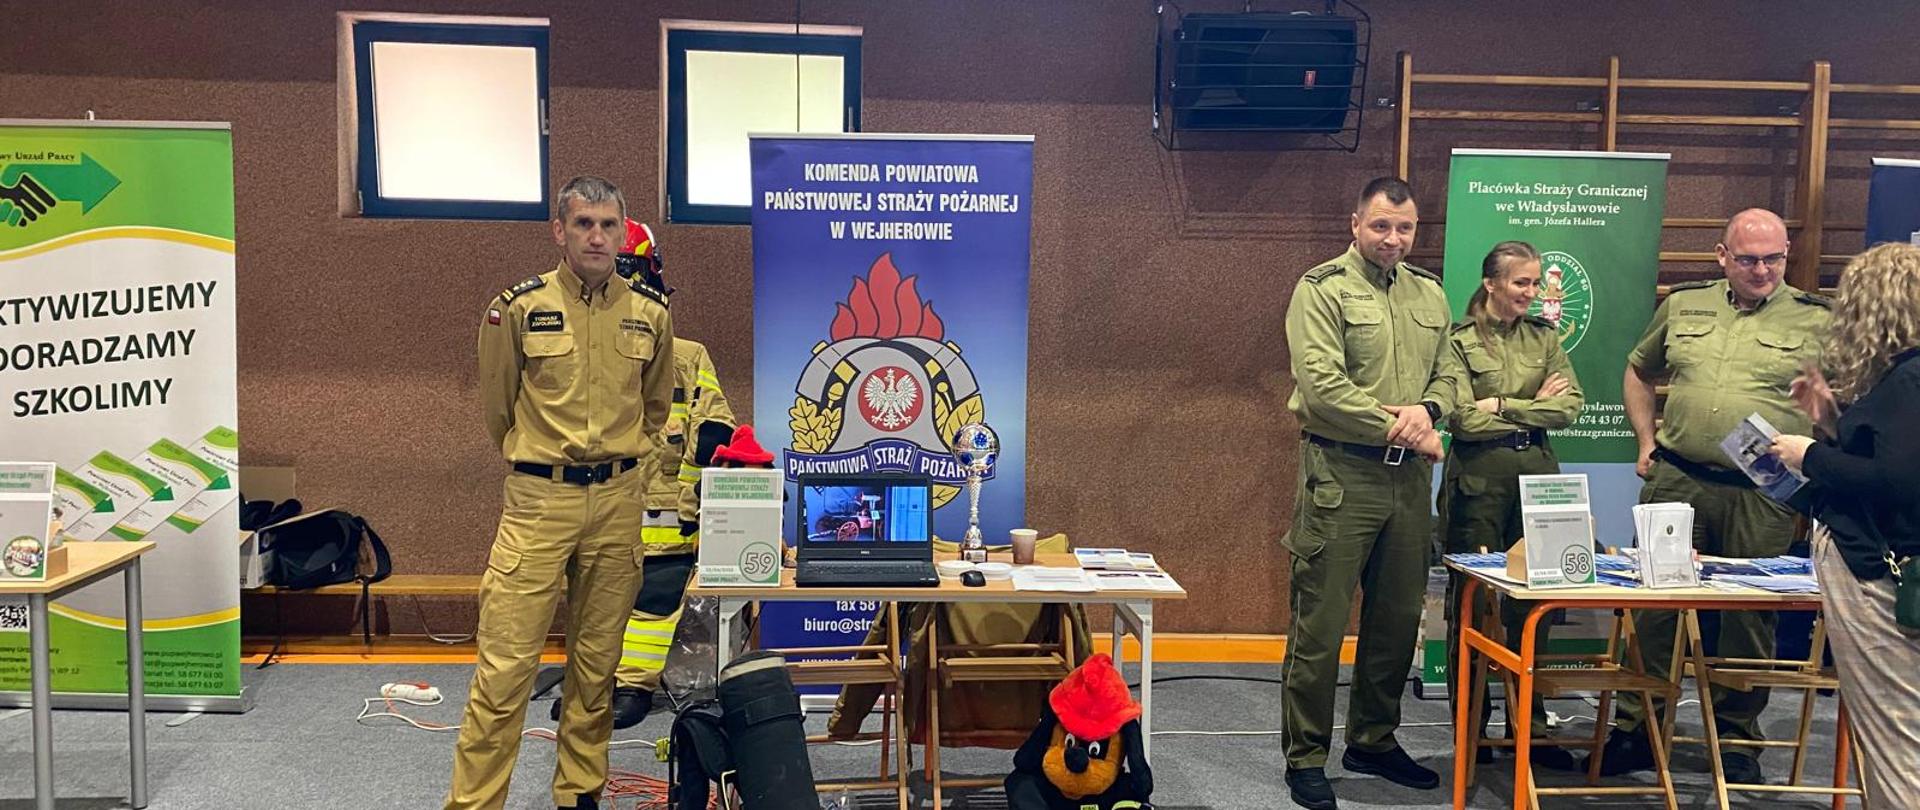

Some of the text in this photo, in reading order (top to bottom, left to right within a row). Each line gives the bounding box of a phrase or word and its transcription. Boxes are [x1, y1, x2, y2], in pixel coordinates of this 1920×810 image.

[804, 163, 979, 183] KOMENDA POWIATOWA
[765, 188, 1019, 213] PAŃSTWOWEJ STRAŻY POŻARNEJ
[1468, 181, 1648, 201] Placówka Straży Granicznej
[1495, 201, 1621, 216] we Władysławowie
[830, 222, 953, 240] W WEJHEROWIE
[1573, 217, 1606, 227] Hallera
[13, 378, 173, 418] SZKOLIMY
[1579, 415, 1625, 425] 674 43 07
[874, 446, 912, 471] STRAŻ
[921, 456, 988, 478] POŻAR
[744, 552, 776, 574] 59
[1565, 552, 1591, 574] 58
